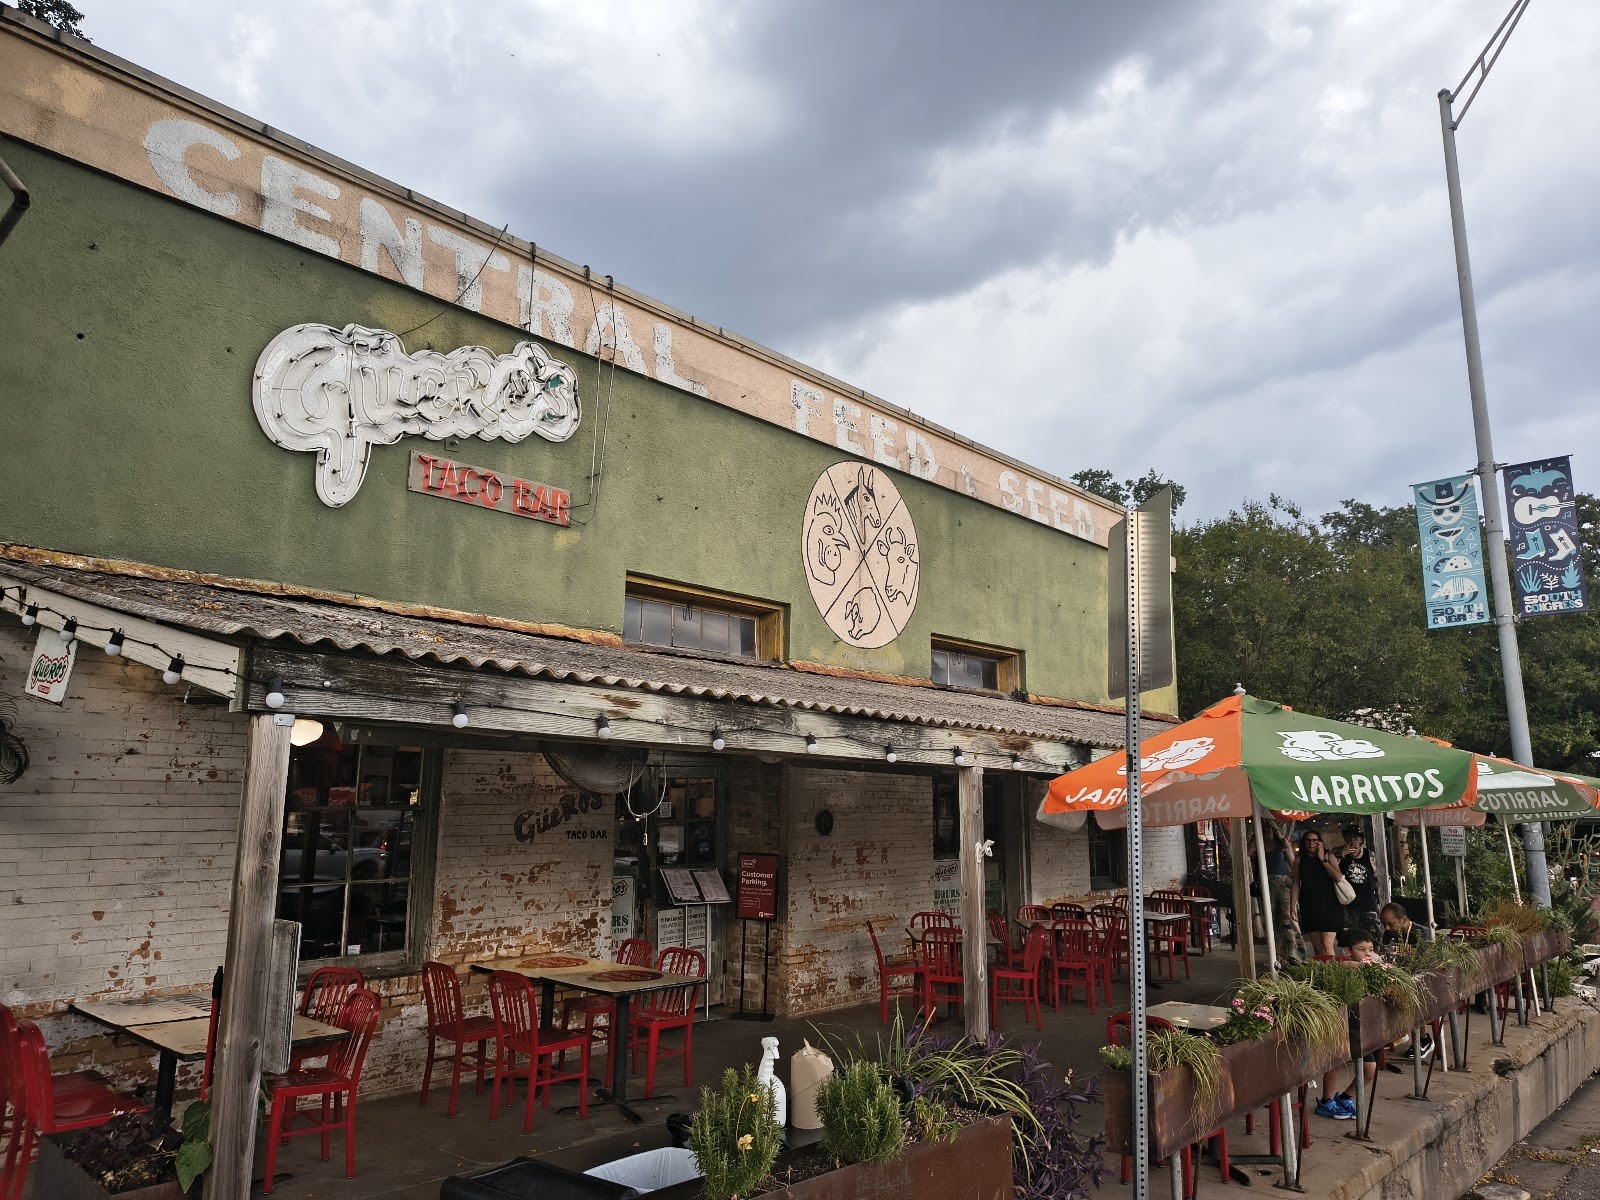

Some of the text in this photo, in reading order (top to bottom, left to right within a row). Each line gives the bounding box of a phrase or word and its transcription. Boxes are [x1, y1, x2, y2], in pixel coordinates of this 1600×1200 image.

[143, 118, 708, 399] CENTRAL
[790, 378, 939, 482] FEED
[999, 470, 1098, 542] SEED
[418, 452, 570, 525] TACO BAR
[1523, 590, 1583, 605] SOUTH
[1432, 603, 1484, 617] SOUTH
[1524, 599, 1584, 613] CONGRESS
[1432, 612, 1485, 625] CONGRESS
[1291, 768, 1445, 806] JARRITOS
[565, 830, 608, 840] TACO BAR
[741, 870, 774, 879] Customer
[741, 878, 768, 887] Parking.
